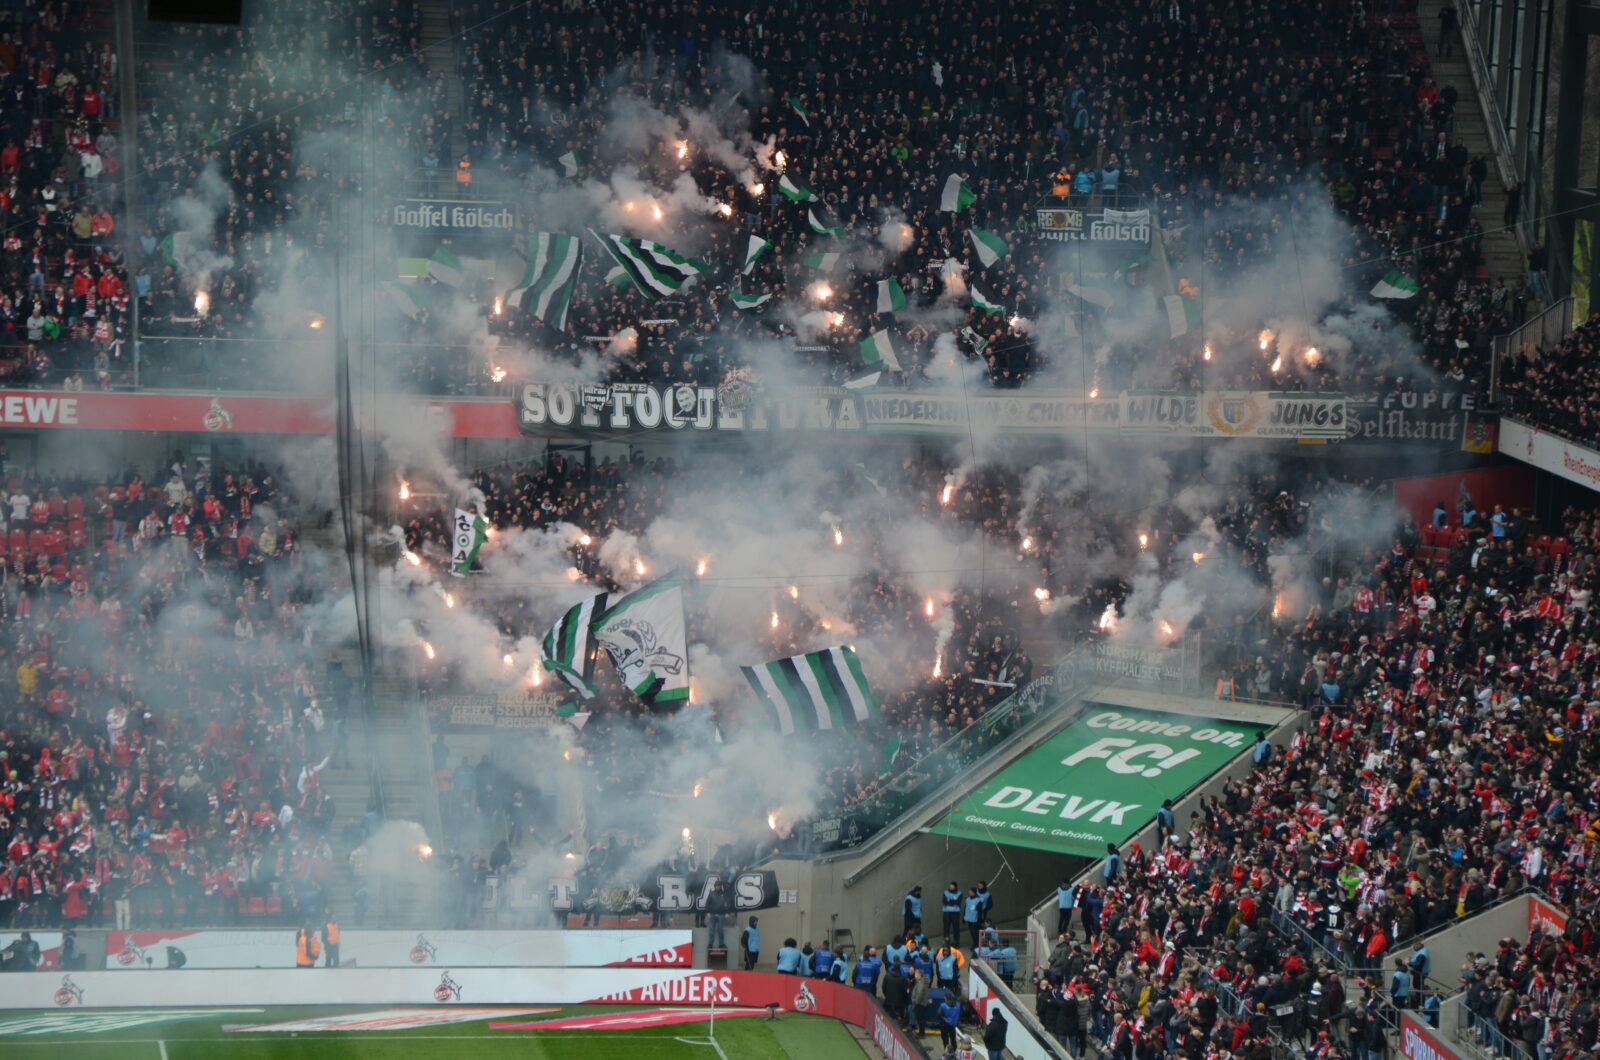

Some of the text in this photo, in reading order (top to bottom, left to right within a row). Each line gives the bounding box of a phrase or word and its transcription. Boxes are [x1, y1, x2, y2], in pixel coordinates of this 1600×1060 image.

[0, 396, 78, 424] EWE
[1128, 398, 1344, 426] WILDE JUNGS
[1086, 712, 1244, 748] Come on,
[1061, 737, 1202, 778] FC!
[983, 786, 1143, 826] DEVK
[965, 815, 1105, 843] Gesagt. Getan. Geholfen.
[640, 976, 739, 1003] ANDERS.
